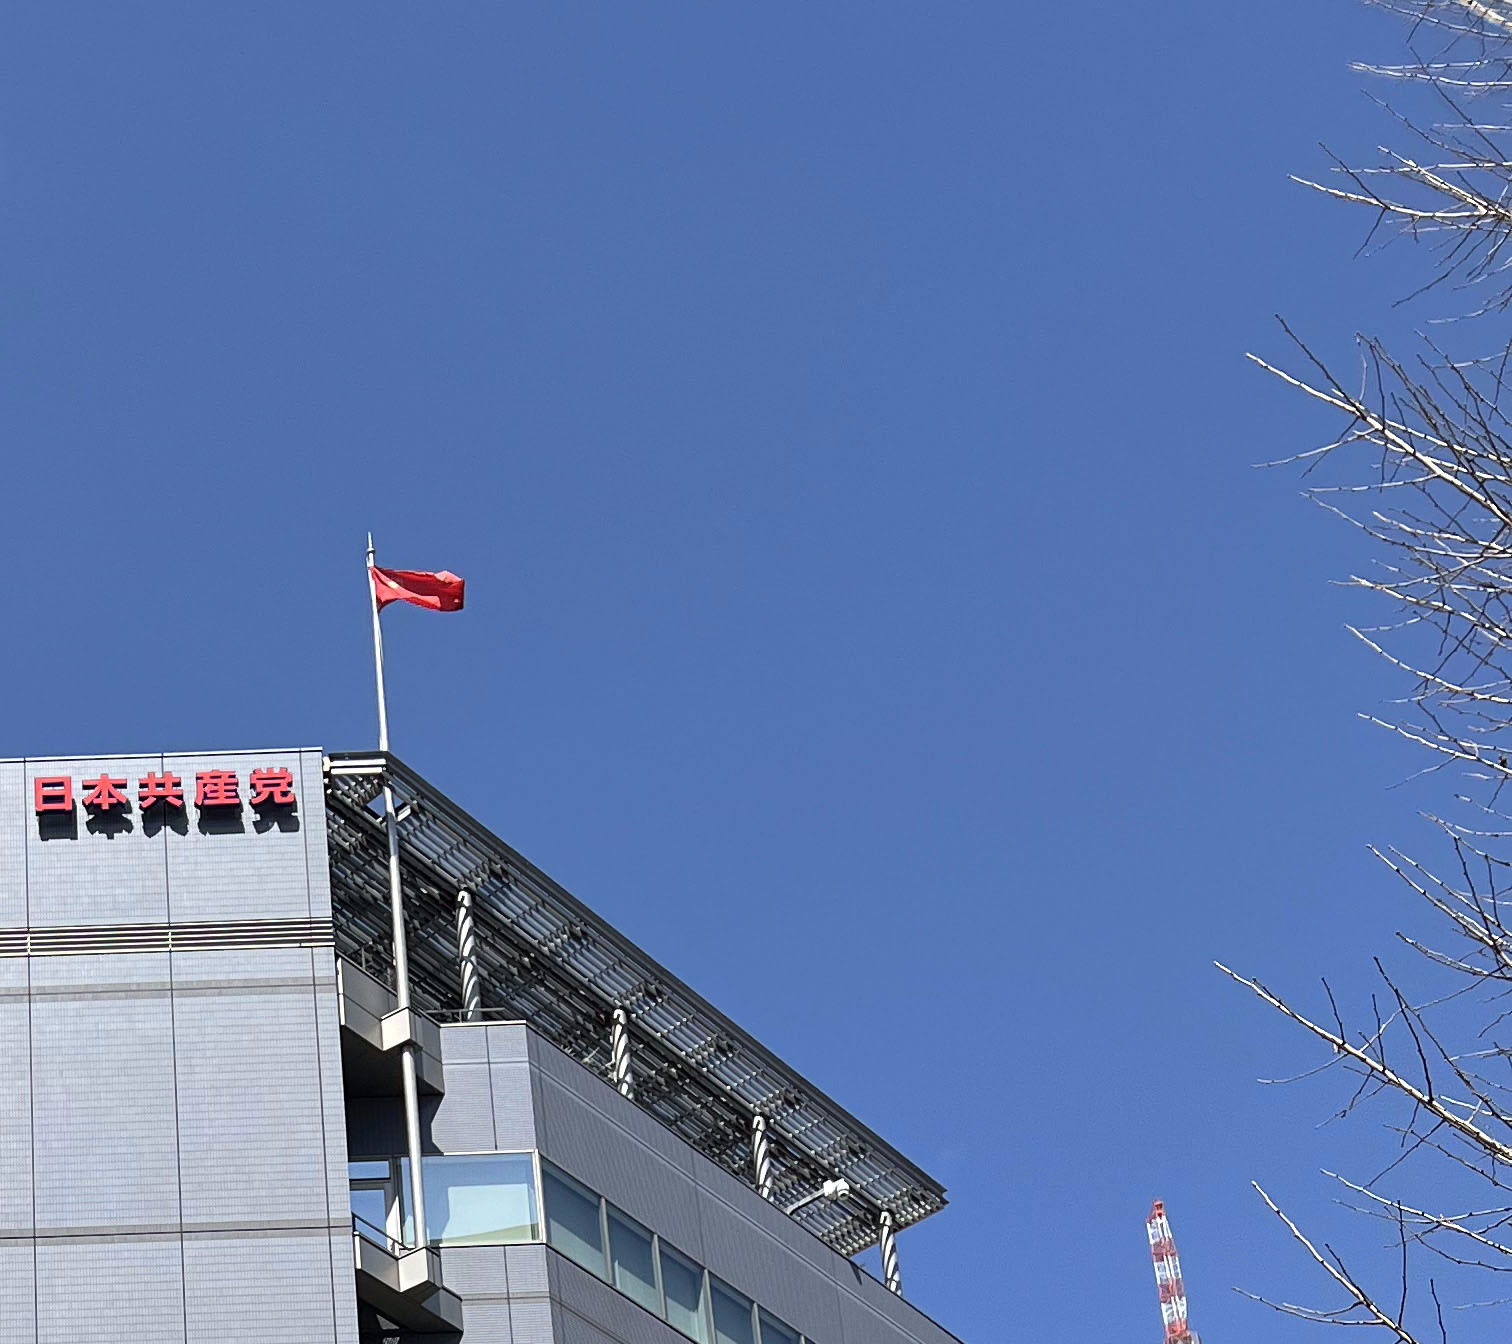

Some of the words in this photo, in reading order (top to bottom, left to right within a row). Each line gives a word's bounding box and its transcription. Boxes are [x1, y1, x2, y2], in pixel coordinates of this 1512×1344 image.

[34, 767, 295, 812] 日本共産党
